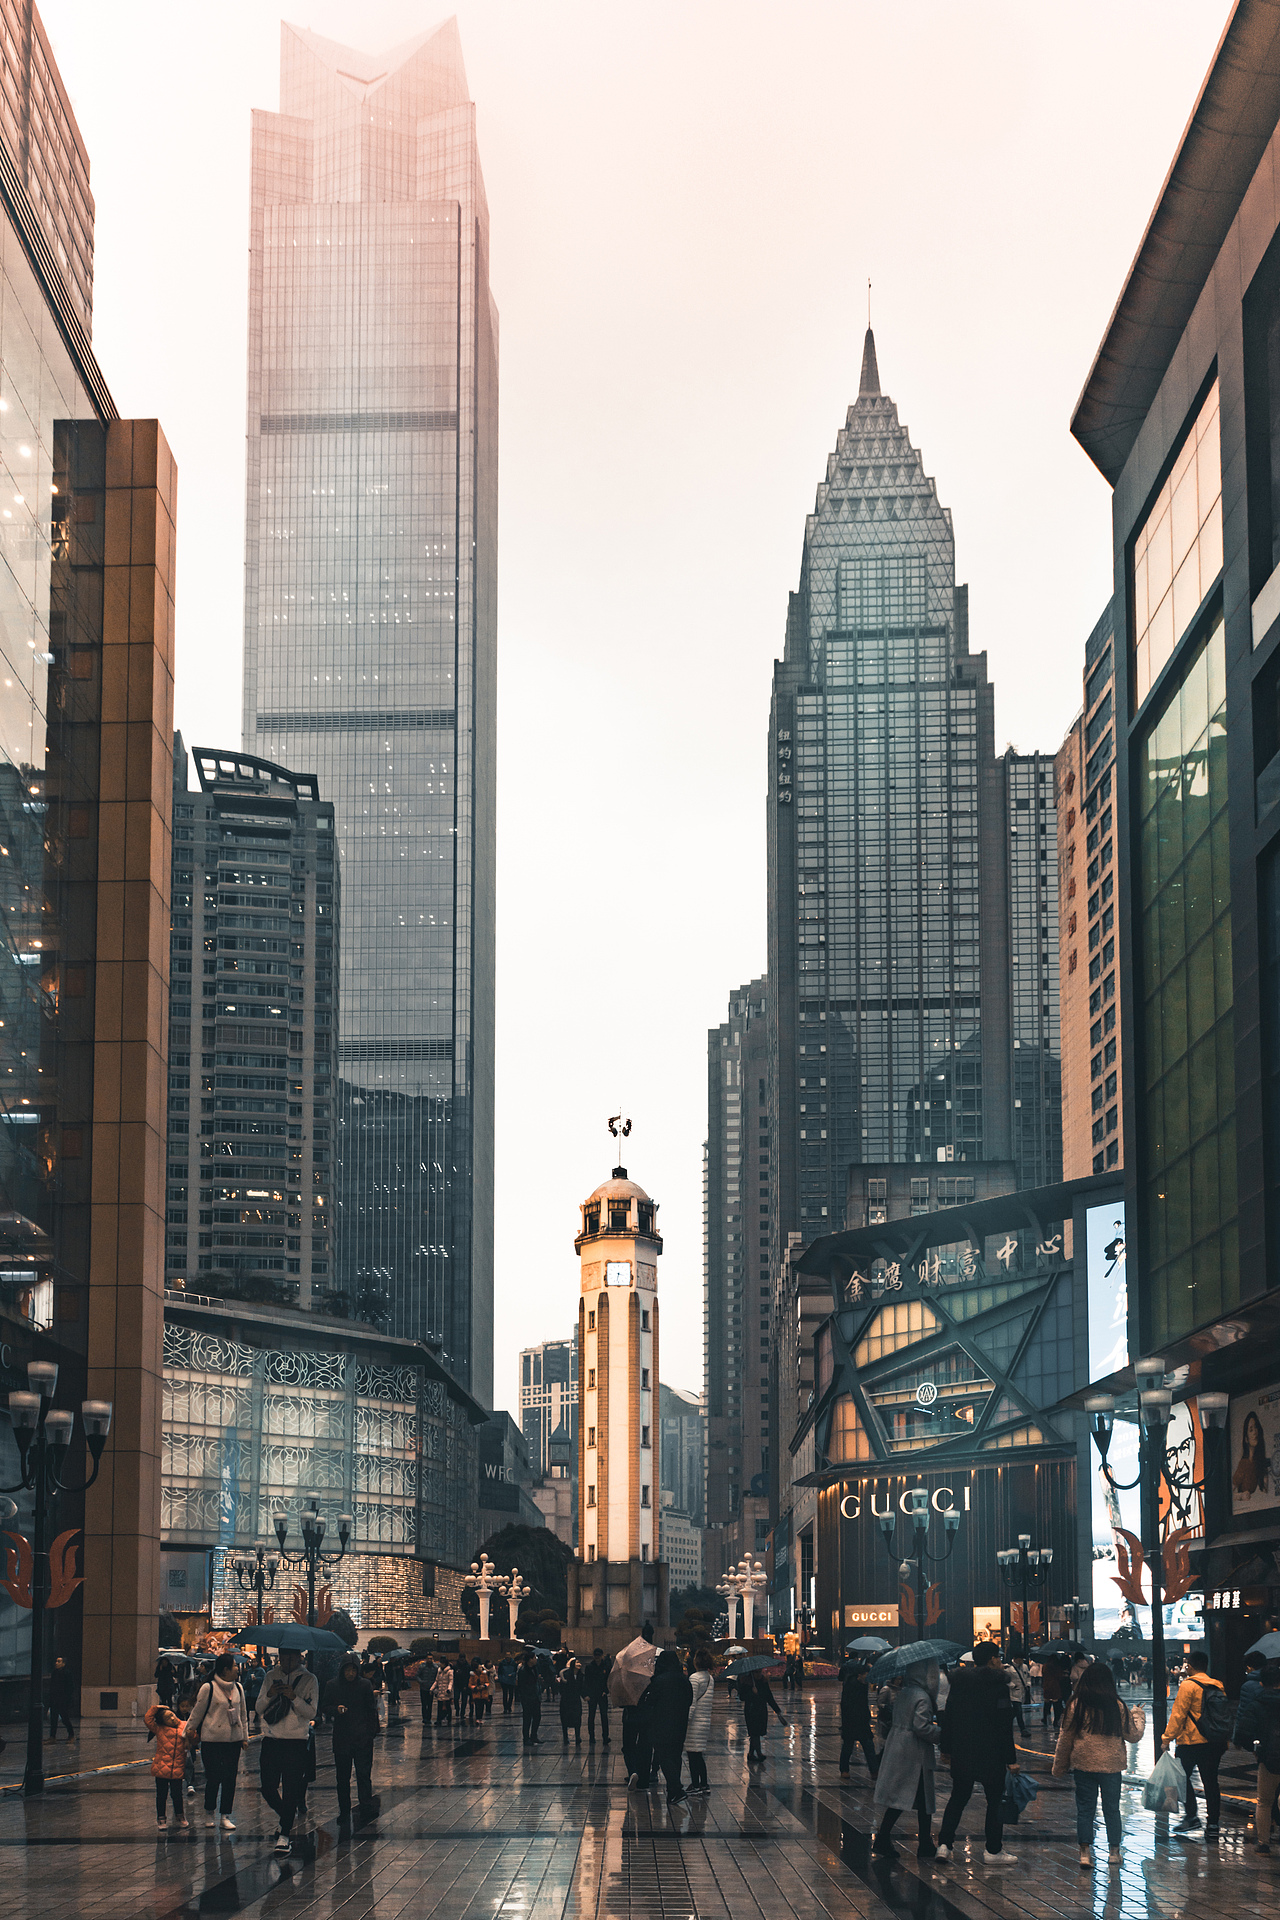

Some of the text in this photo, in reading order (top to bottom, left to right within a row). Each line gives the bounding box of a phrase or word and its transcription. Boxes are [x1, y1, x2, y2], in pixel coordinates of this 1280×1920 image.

[844, 1234, 1062, 1300] 金鹰财富中心
[840, 1486, 971, 1519] GUCCI
[1213, 1590, 1241, 1610] 肯德基
[851, 1611, 892, 1622] GUCCI
